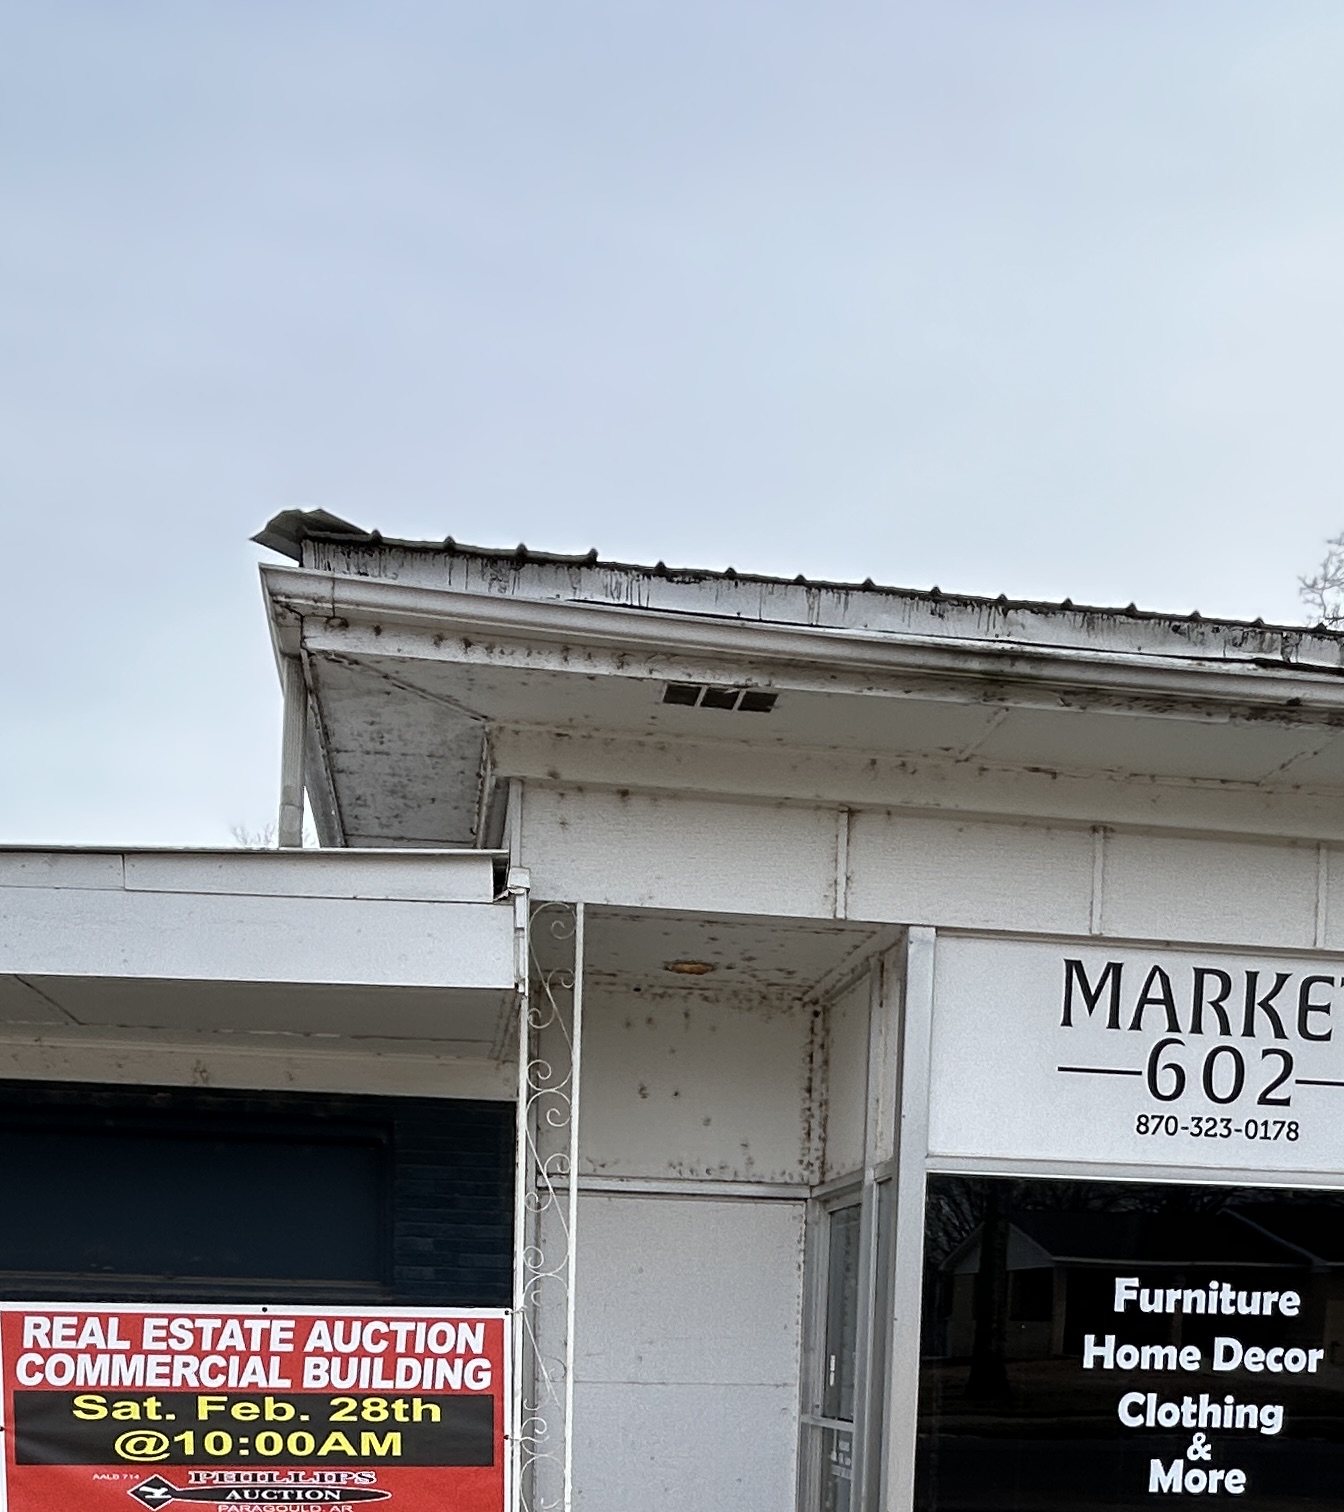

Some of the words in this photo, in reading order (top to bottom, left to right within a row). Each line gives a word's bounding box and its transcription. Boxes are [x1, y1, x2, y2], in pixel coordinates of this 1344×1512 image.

[1147, 1037, 1294, 1107] 602
[1135, 1114, 1299, 1142] 870-323-0178
[1114, 1277, 1301, 1316] Furniture
[22, 1316, 130, 1350] REAL
[142, 1317, 295, 1352] ESTATE
[303, 1320, 485, 1354] AUCTION
[1083, 1334, 1201, 1371] Home
[1213, 1336, 1324, 1373] Decor
[15, 1352, 292, 1388] COMMERCIAL
[302, 1356, 492, 1390] BUILDING
[73, 1394, 176, 1420] Sat.
[197, 1395, 310, 1421] Feb.
[329, 1397, 441, 1422] 28th
[1118, 1391, 1284, 1434] Clothing
[114, 1429, 402, 1461] @10:00AM
[1187, 1432, 1211, 1460] &
[188, 1471, 377, 1484] PHILLIPS
[1148, 1459, 1247, 1494] More
[225, 1489, 341, 1500] AUCTION
[329, 1505, 354, 1512] AR
